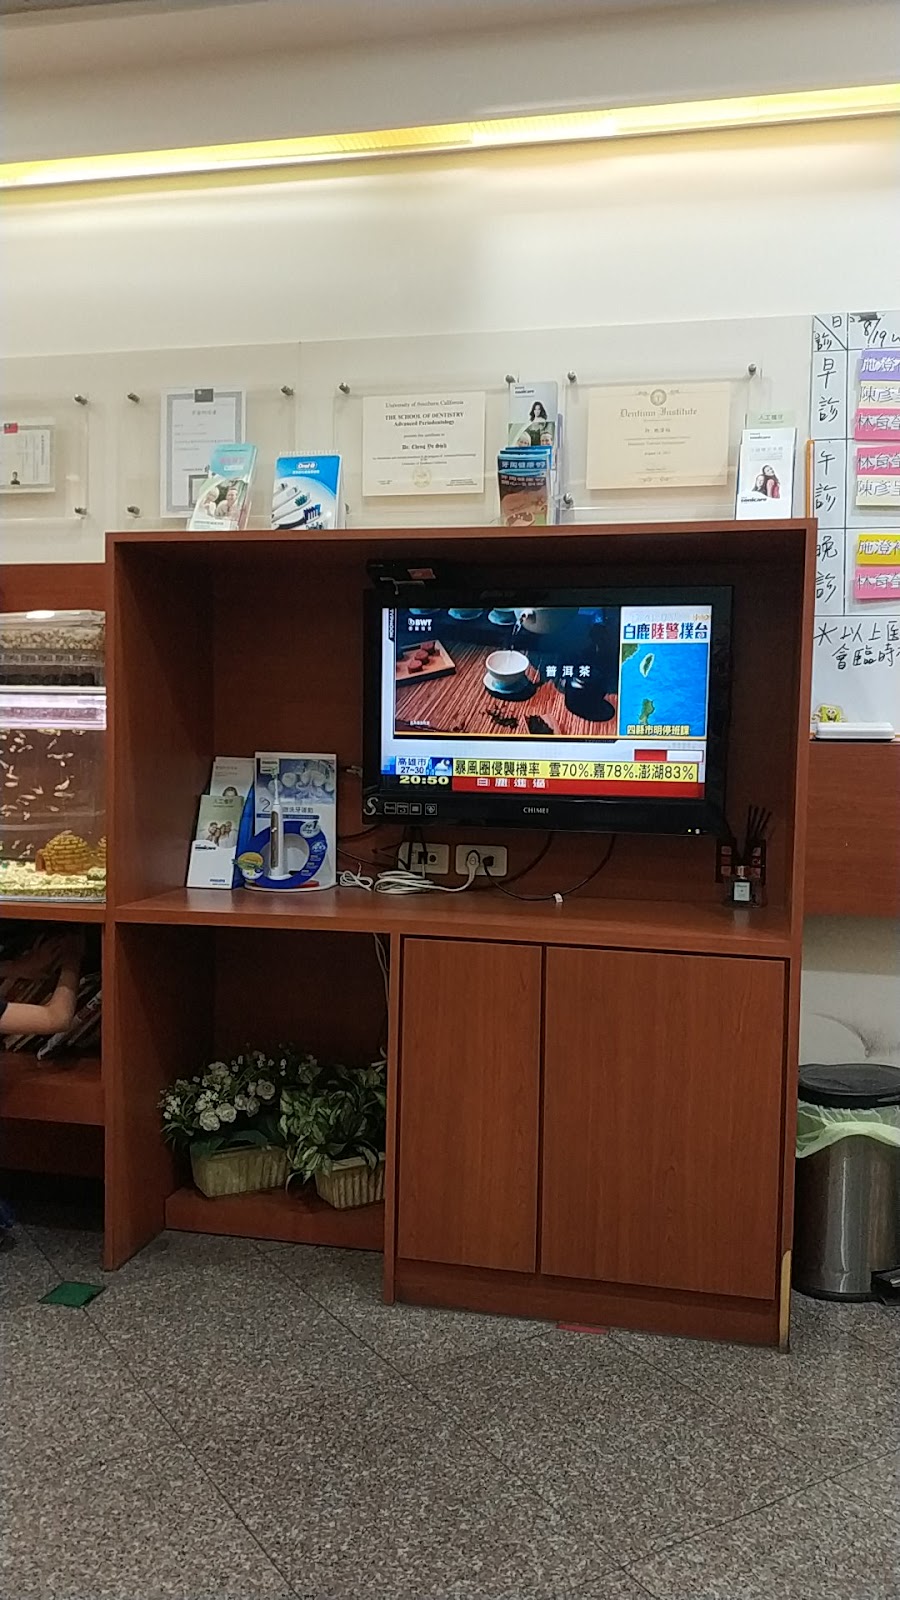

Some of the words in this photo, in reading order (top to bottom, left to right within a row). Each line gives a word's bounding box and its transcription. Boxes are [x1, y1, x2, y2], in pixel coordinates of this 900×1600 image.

[431, 411, 464, 419] DENTISTRY
[622, 621, 709, 641] 白鹿陸警撲台
[545, 665, 591, 679] 普洱茶
[397, 757, 427, 767] 高雄市
[454, 760, 541, 777] 暴風圈侵襲機率
[399, 775, 450, 786] 20:50
